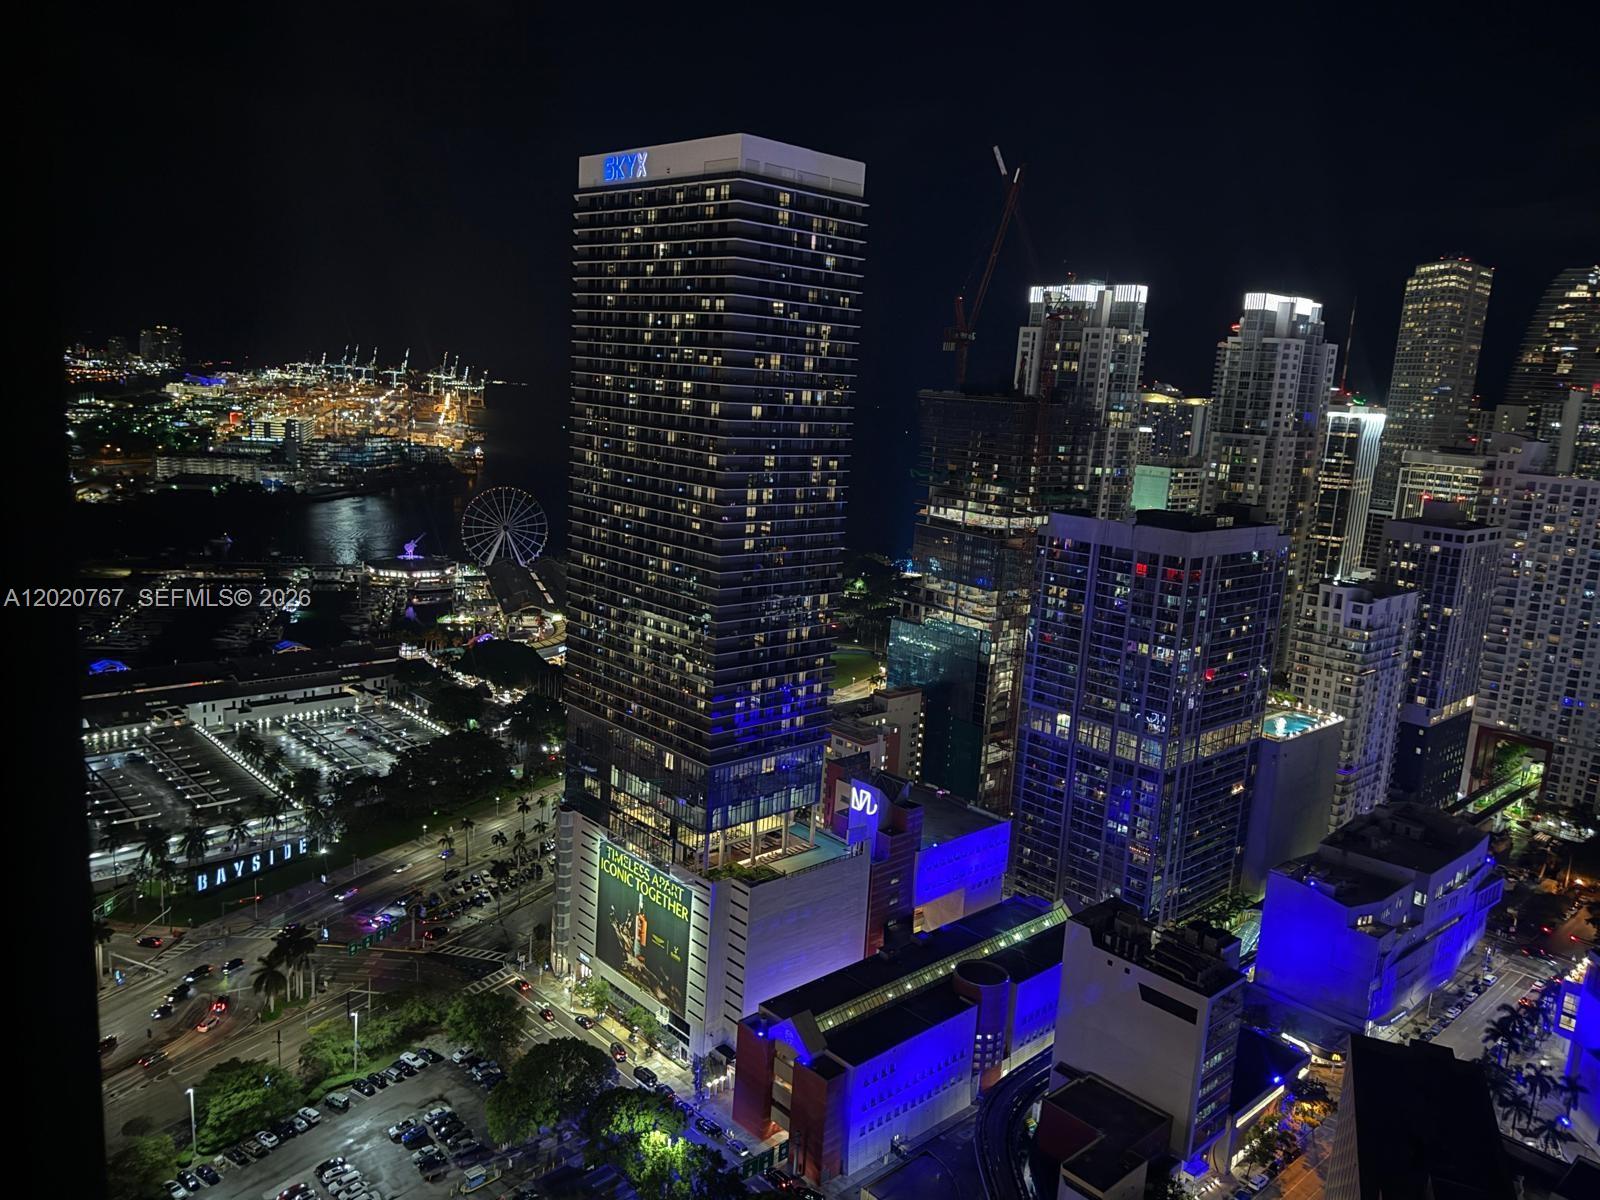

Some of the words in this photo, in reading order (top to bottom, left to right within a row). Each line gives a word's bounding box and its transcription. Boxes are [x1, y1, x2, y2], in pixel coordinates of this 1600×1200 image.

[197, 837, 307, 892] BAYSIDE
[600, 857, 634, 888] ICONIC
[635, 878, 689, 922] TOGETHER
[606, 845, 650, 882] TIMELESS
